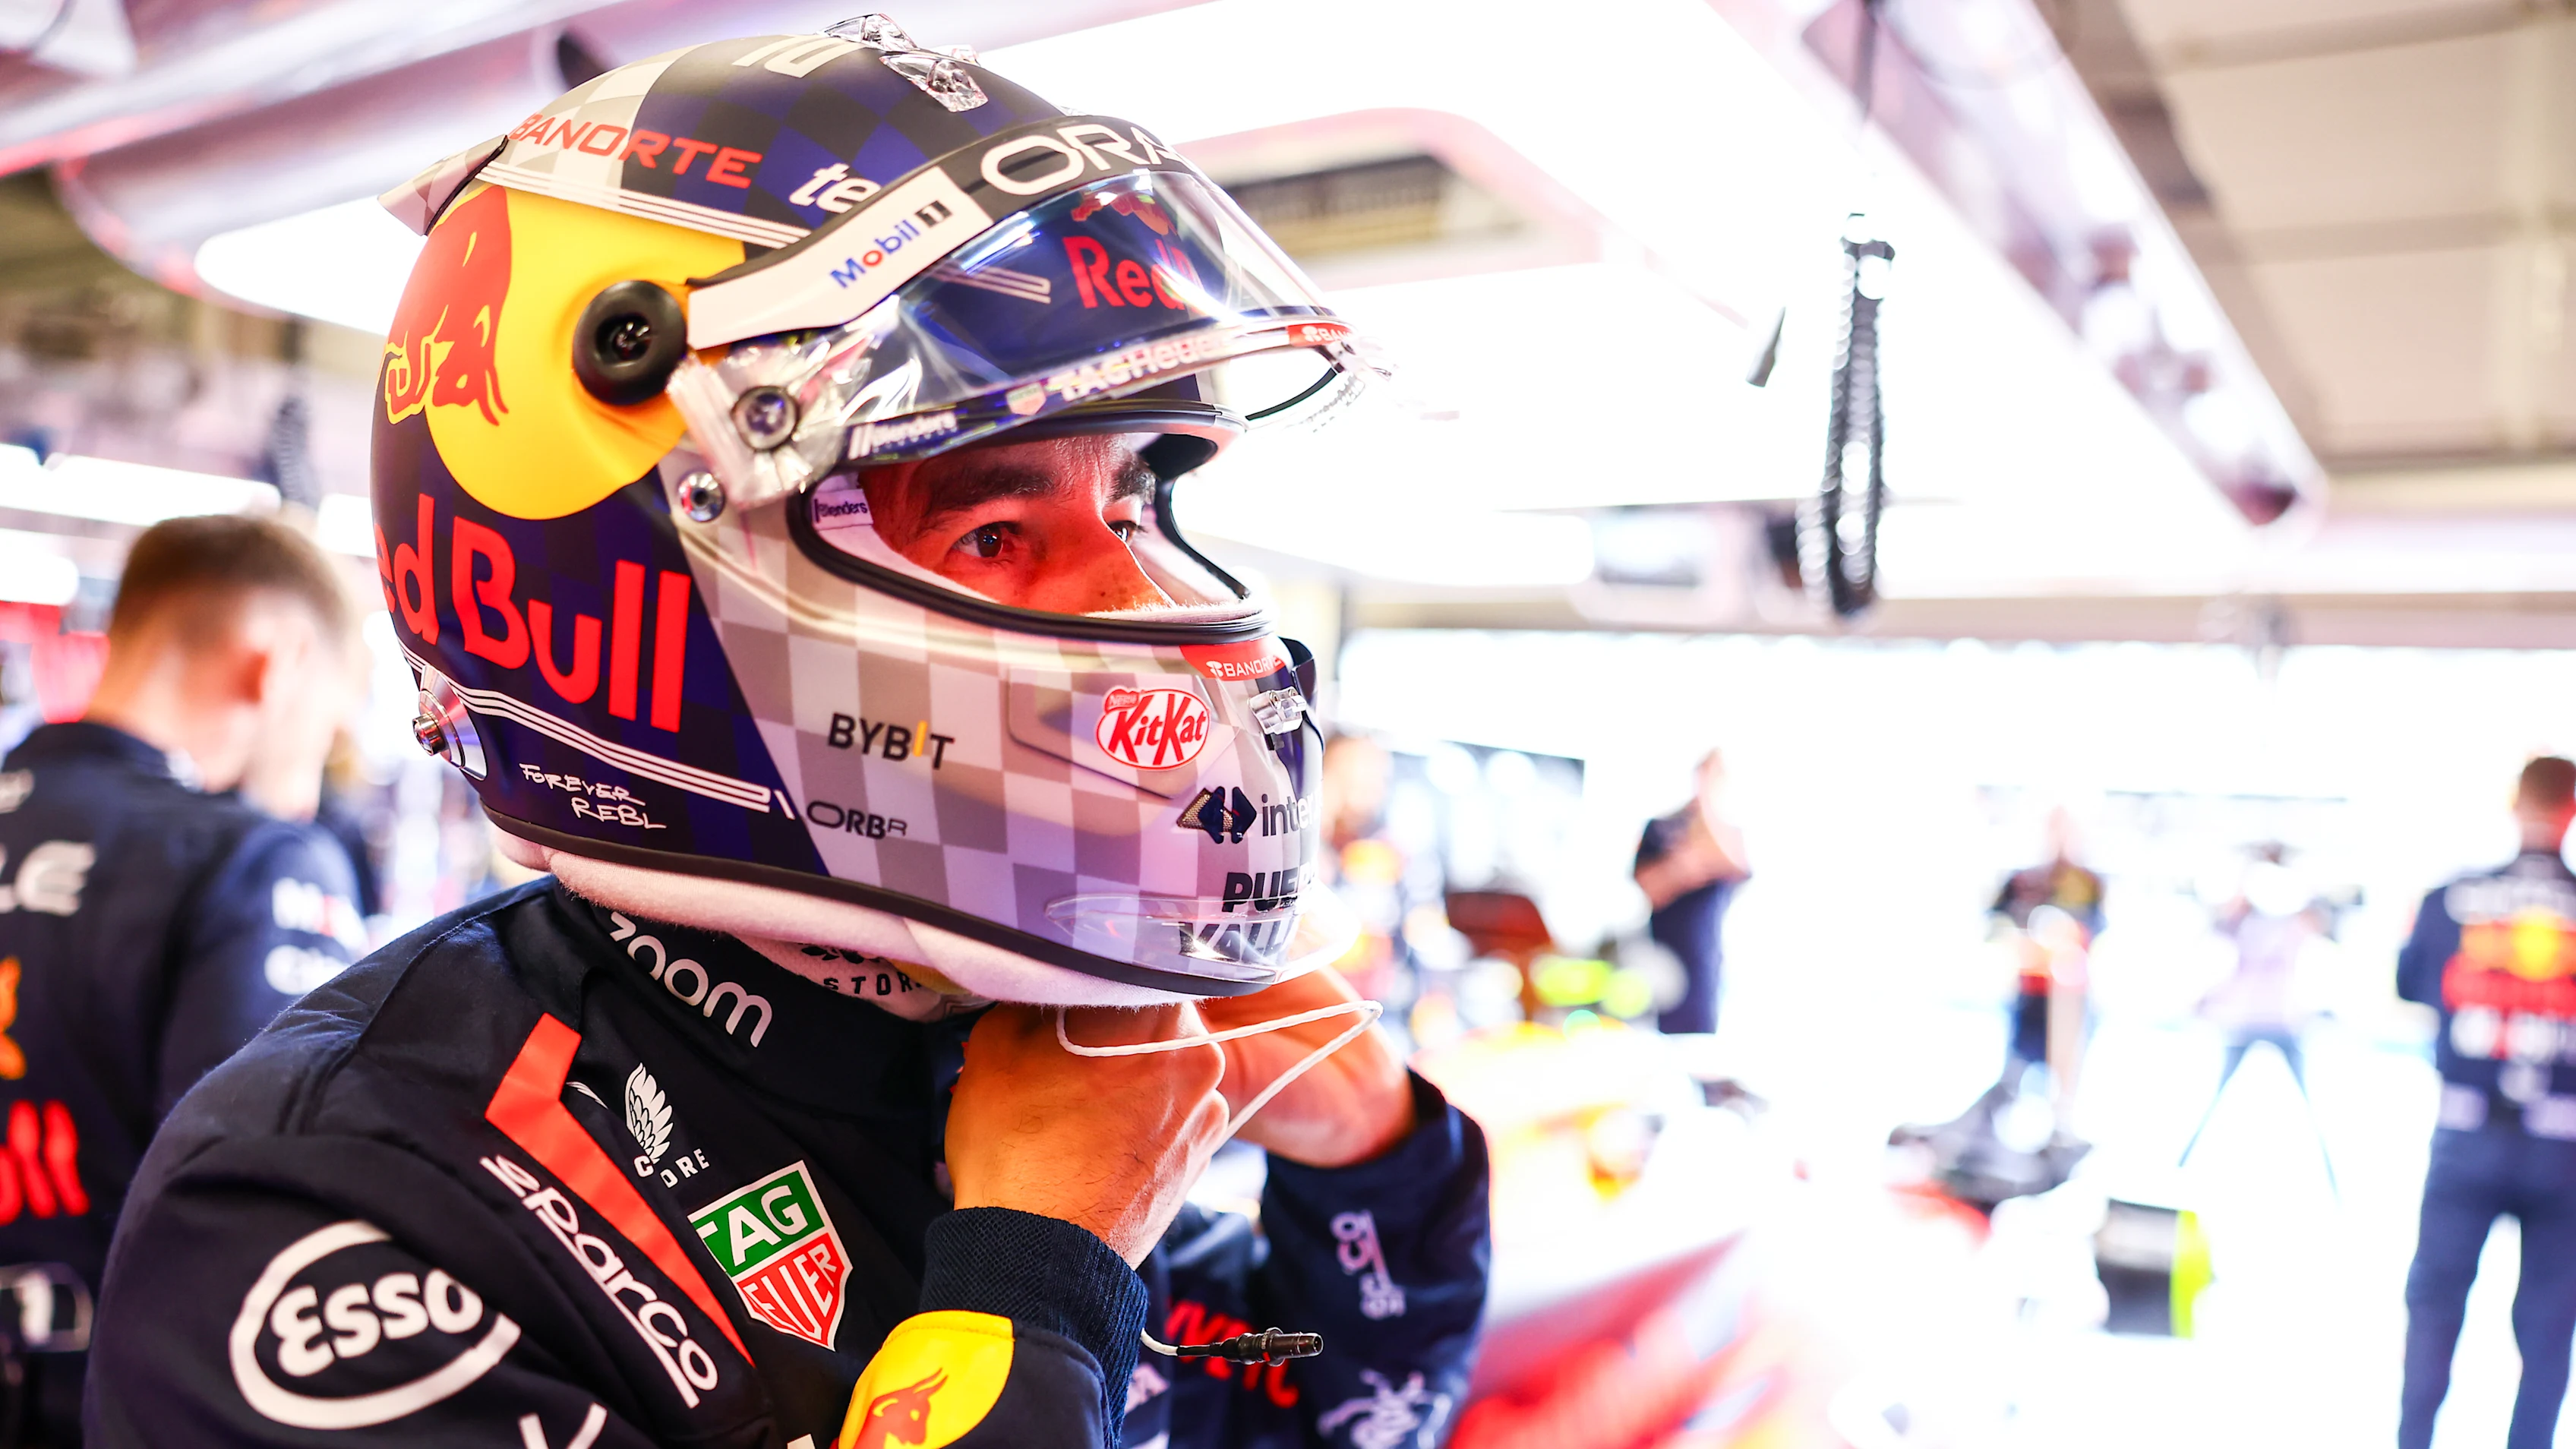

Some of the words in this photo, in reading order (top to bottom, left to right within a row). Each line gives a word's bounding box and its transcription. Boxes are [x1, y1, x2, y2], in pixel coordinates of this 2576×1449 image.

[508, 113, 762, 188] BANORTE
[830, 219, 920, 289] Mobil
[452, 516, 691, 733] Bull
[1222, 655, 1282, 677] BANORTE
[829, 712, 955, 770] BYBIT
[519, 762, 646, 807] FOREVER
[571, 797, 667, 829] REBL
[610, 911, 772, 1048] zoom
[823, 971, 922, 996] STOR
[633, 1148, 710, 1189] CORE
[479, 1154, 718, 1409] sparco
